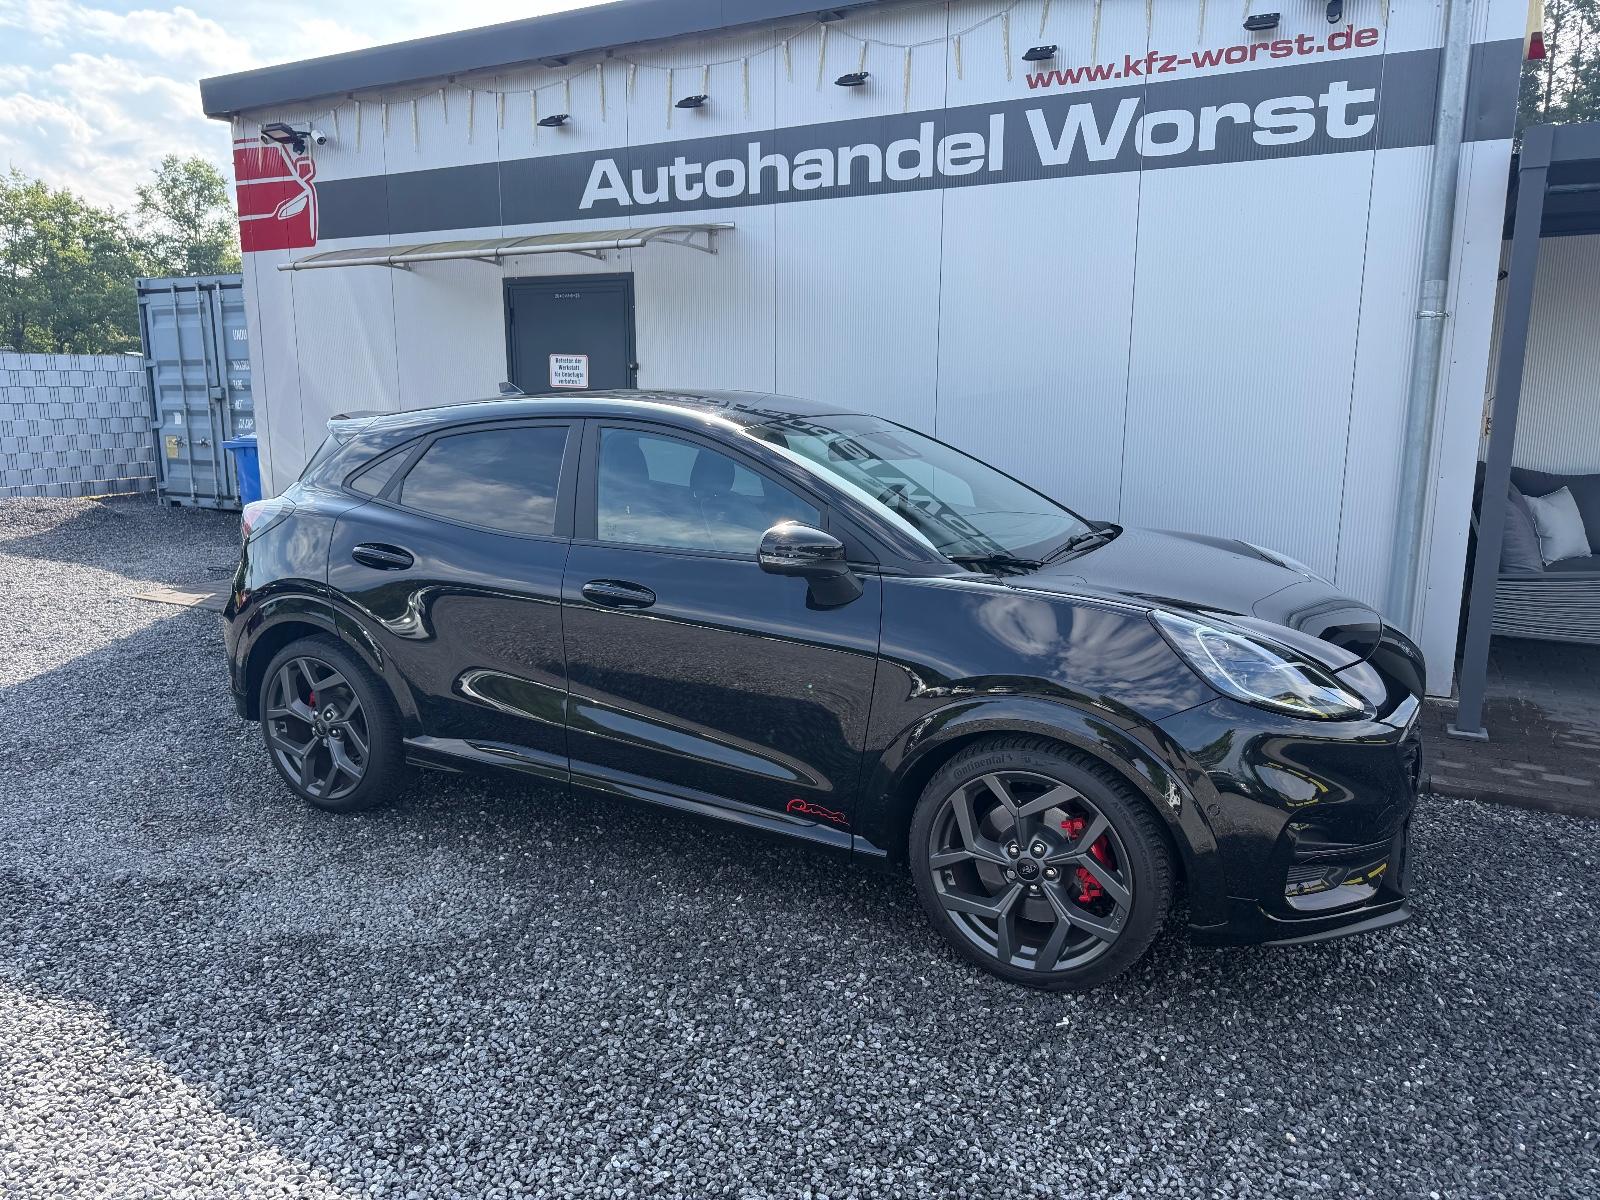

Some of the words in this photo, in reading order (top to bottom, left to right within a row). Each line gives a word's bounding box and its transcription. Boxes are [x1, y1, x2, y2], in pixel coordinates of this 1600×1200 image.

[1025, 24, 1380, 90] www.kfz-worst.de
[578, 112, 1006, 210] Autohandel
[1024, 79, 1377, 167] Worst
[953, 753, 1005, 779] Continental
